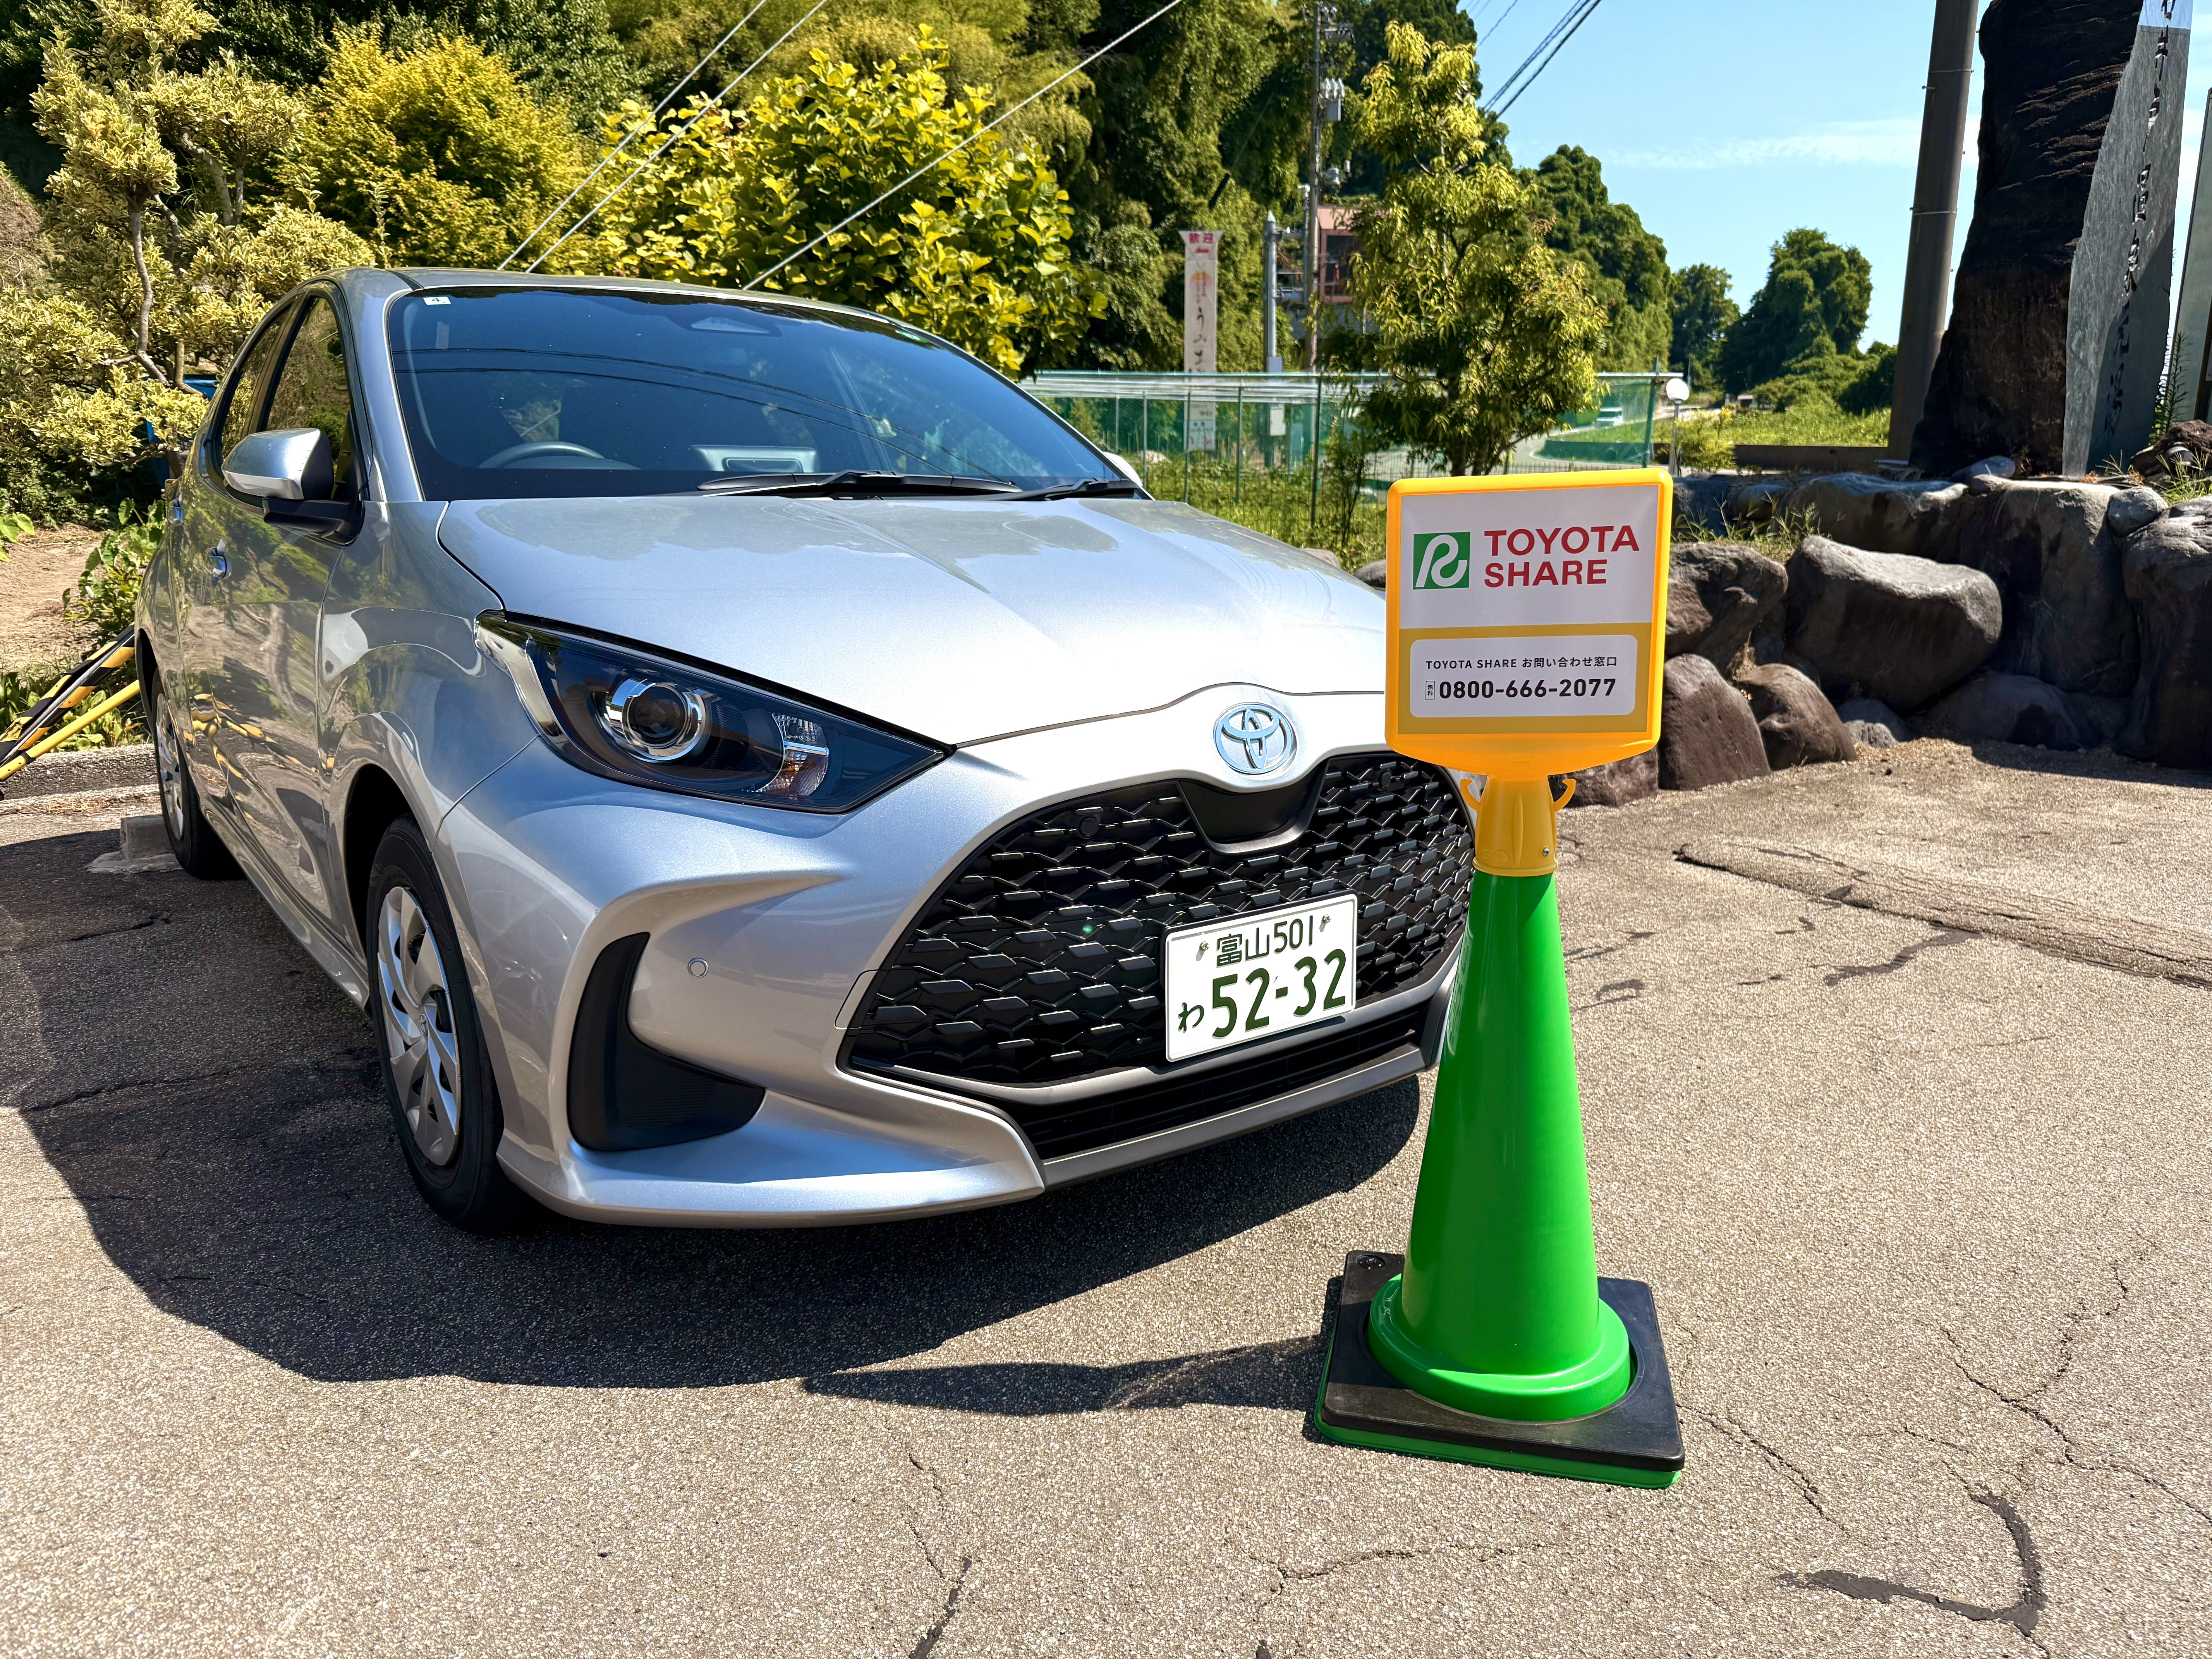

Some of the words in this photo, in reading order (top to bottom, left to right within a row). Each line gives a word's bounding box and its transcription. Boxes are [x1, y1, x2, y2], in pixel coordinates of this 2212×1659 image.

[1484, 526, 1639, 556] TOYOTA
[1484, 560, 1607, 587] SHARE
[1425, 660, 1472, 669] TOYOTA
[1477, 659, 1517, 668] SHARE
[1522, 656, 1617, 668] お問い合わせ窓口
[1439, 678, 1616, 699] 0800-666-2077
[1216, 915, 1313, 967] 富山501
[1178, 1002, 1204, 1032] わ
[1212, 948, 1346, 1039] 52-32
